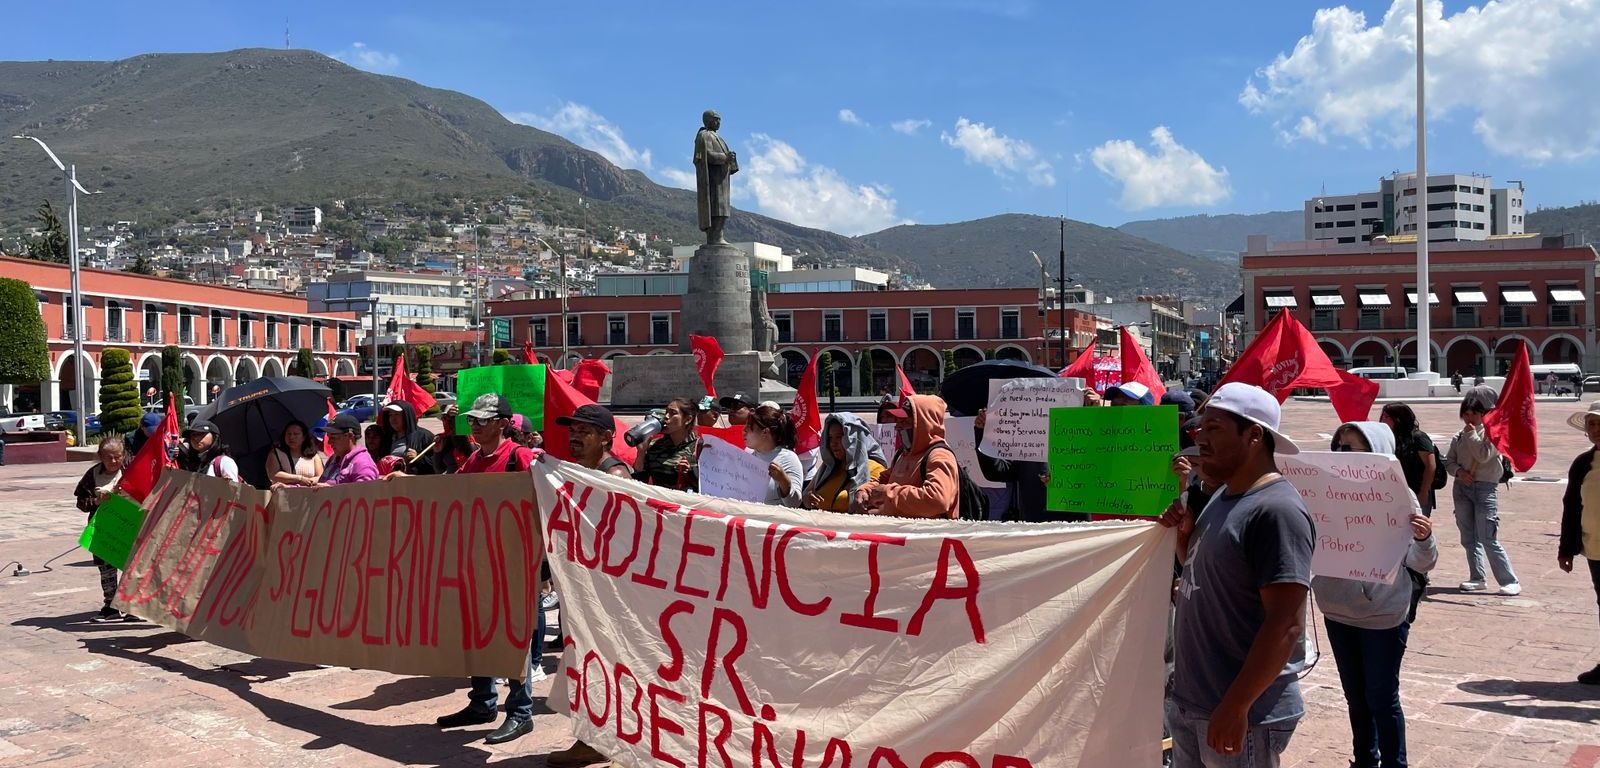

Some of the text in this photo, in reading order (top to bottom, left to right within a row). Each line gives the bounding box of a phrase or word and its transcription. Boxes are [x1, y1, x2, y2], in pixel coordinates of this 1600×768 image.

[1281, 461, 1319, 477] dimos
[1390, 473, 1399, 483] a
[1326, 485, 1394, 503] demandas
[1344, 513, 1374, 531] para
[1386, 513, 1398, 527] la
[1318, 535, 1365, 553] Pobres
[547, 480, 986, 644] AUDIENCIA
[656, 600, 777, 722] SR.
